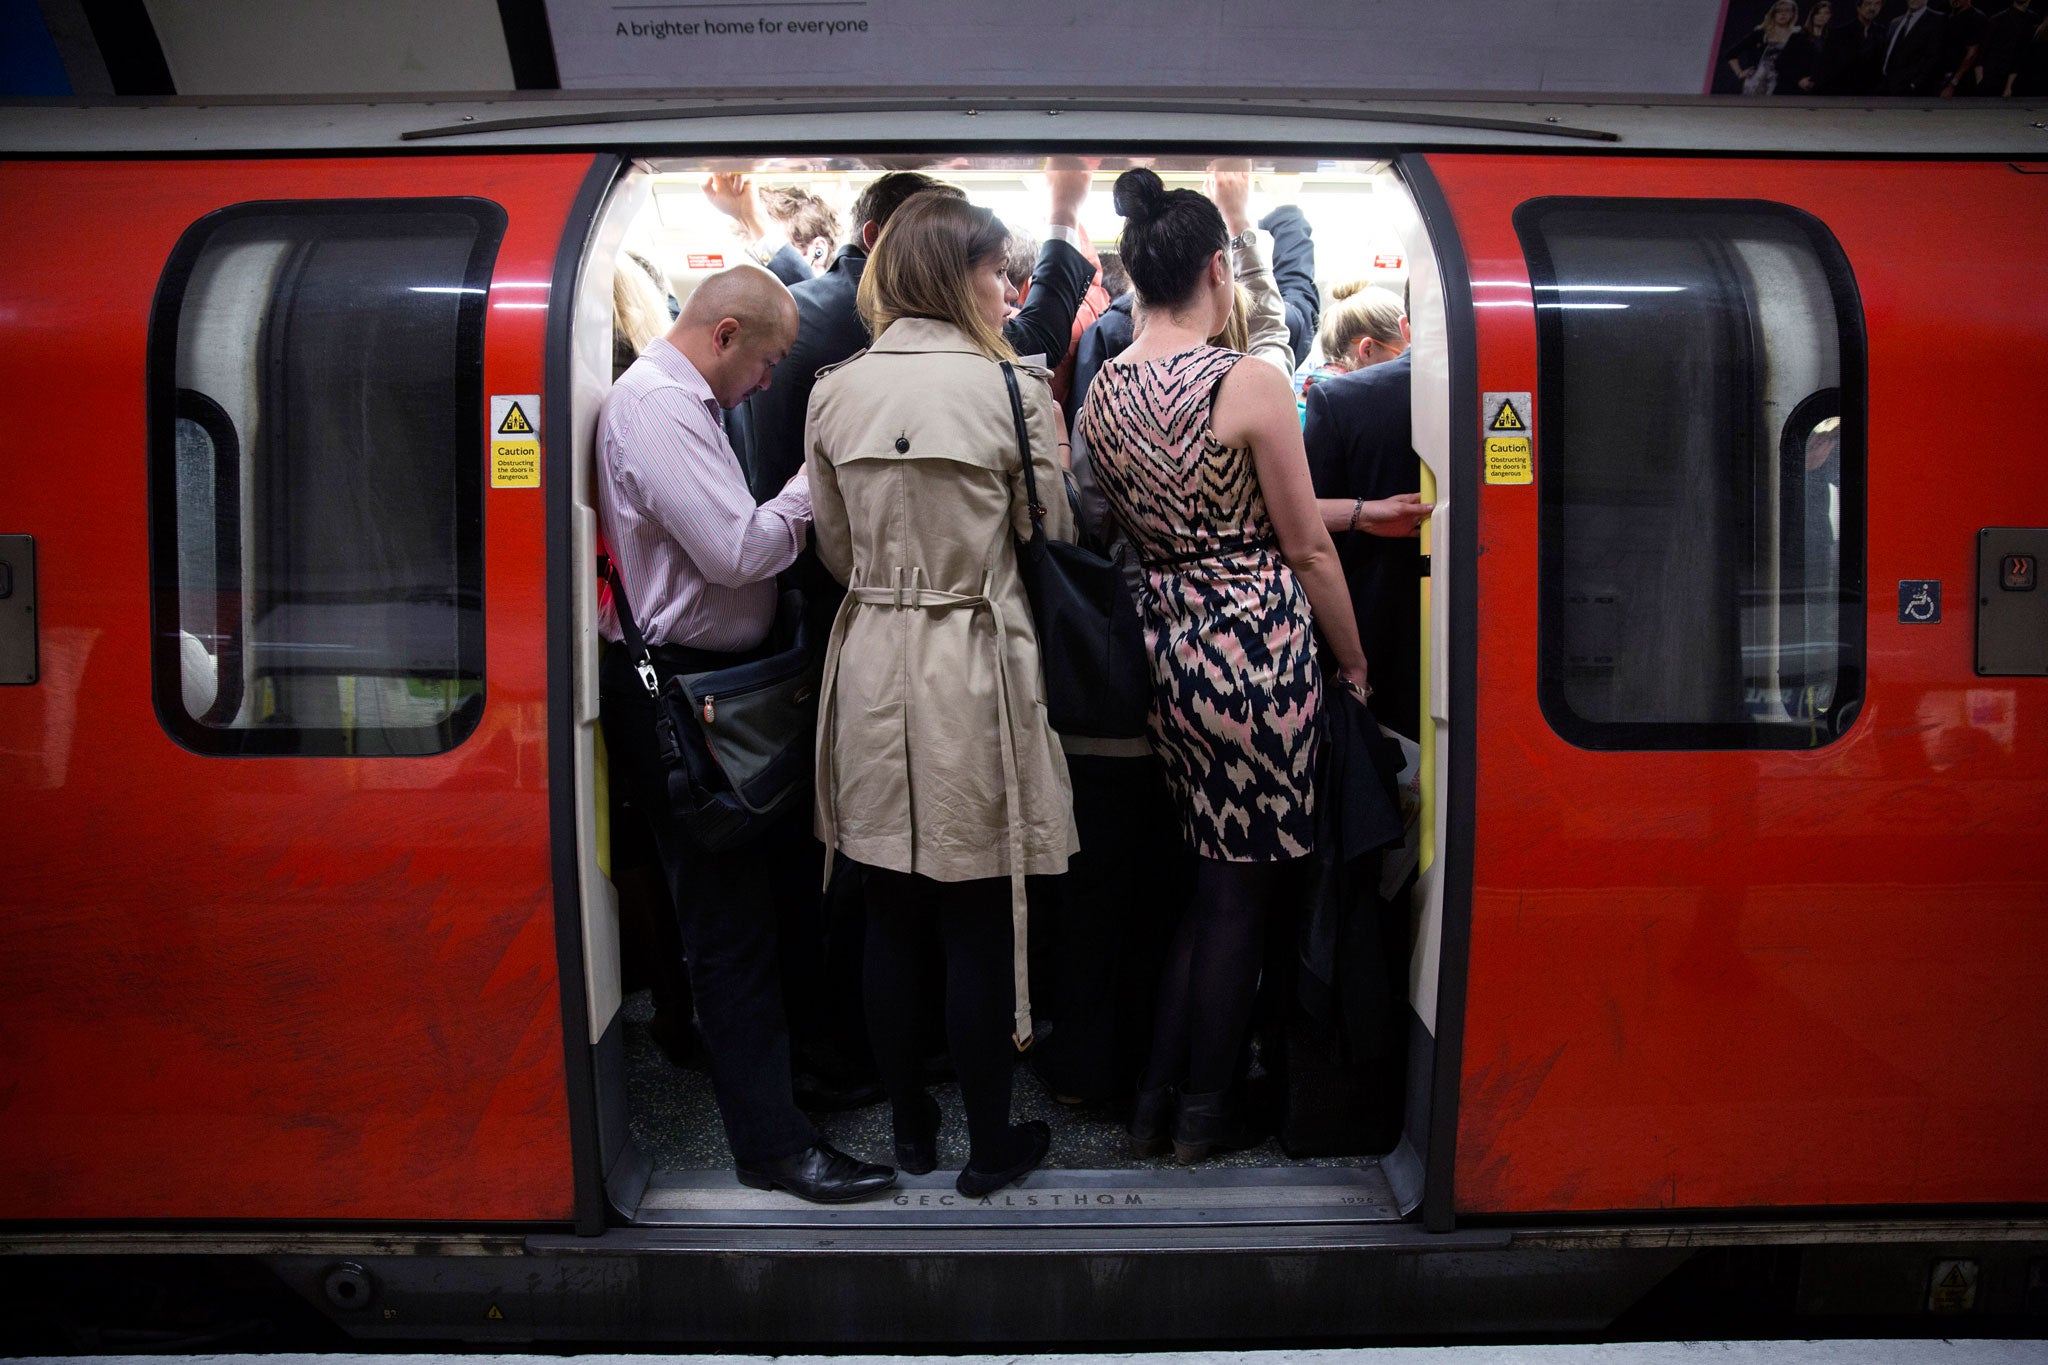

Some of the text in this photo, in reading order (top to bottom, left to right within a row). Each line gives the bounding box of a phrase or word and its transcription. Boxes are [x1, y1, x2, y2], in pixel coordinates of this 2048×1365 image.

[616, 18, 868, 39] A brighter home for everyone
[893, 1194, 1143, 1207] GEC ALSTHOM
